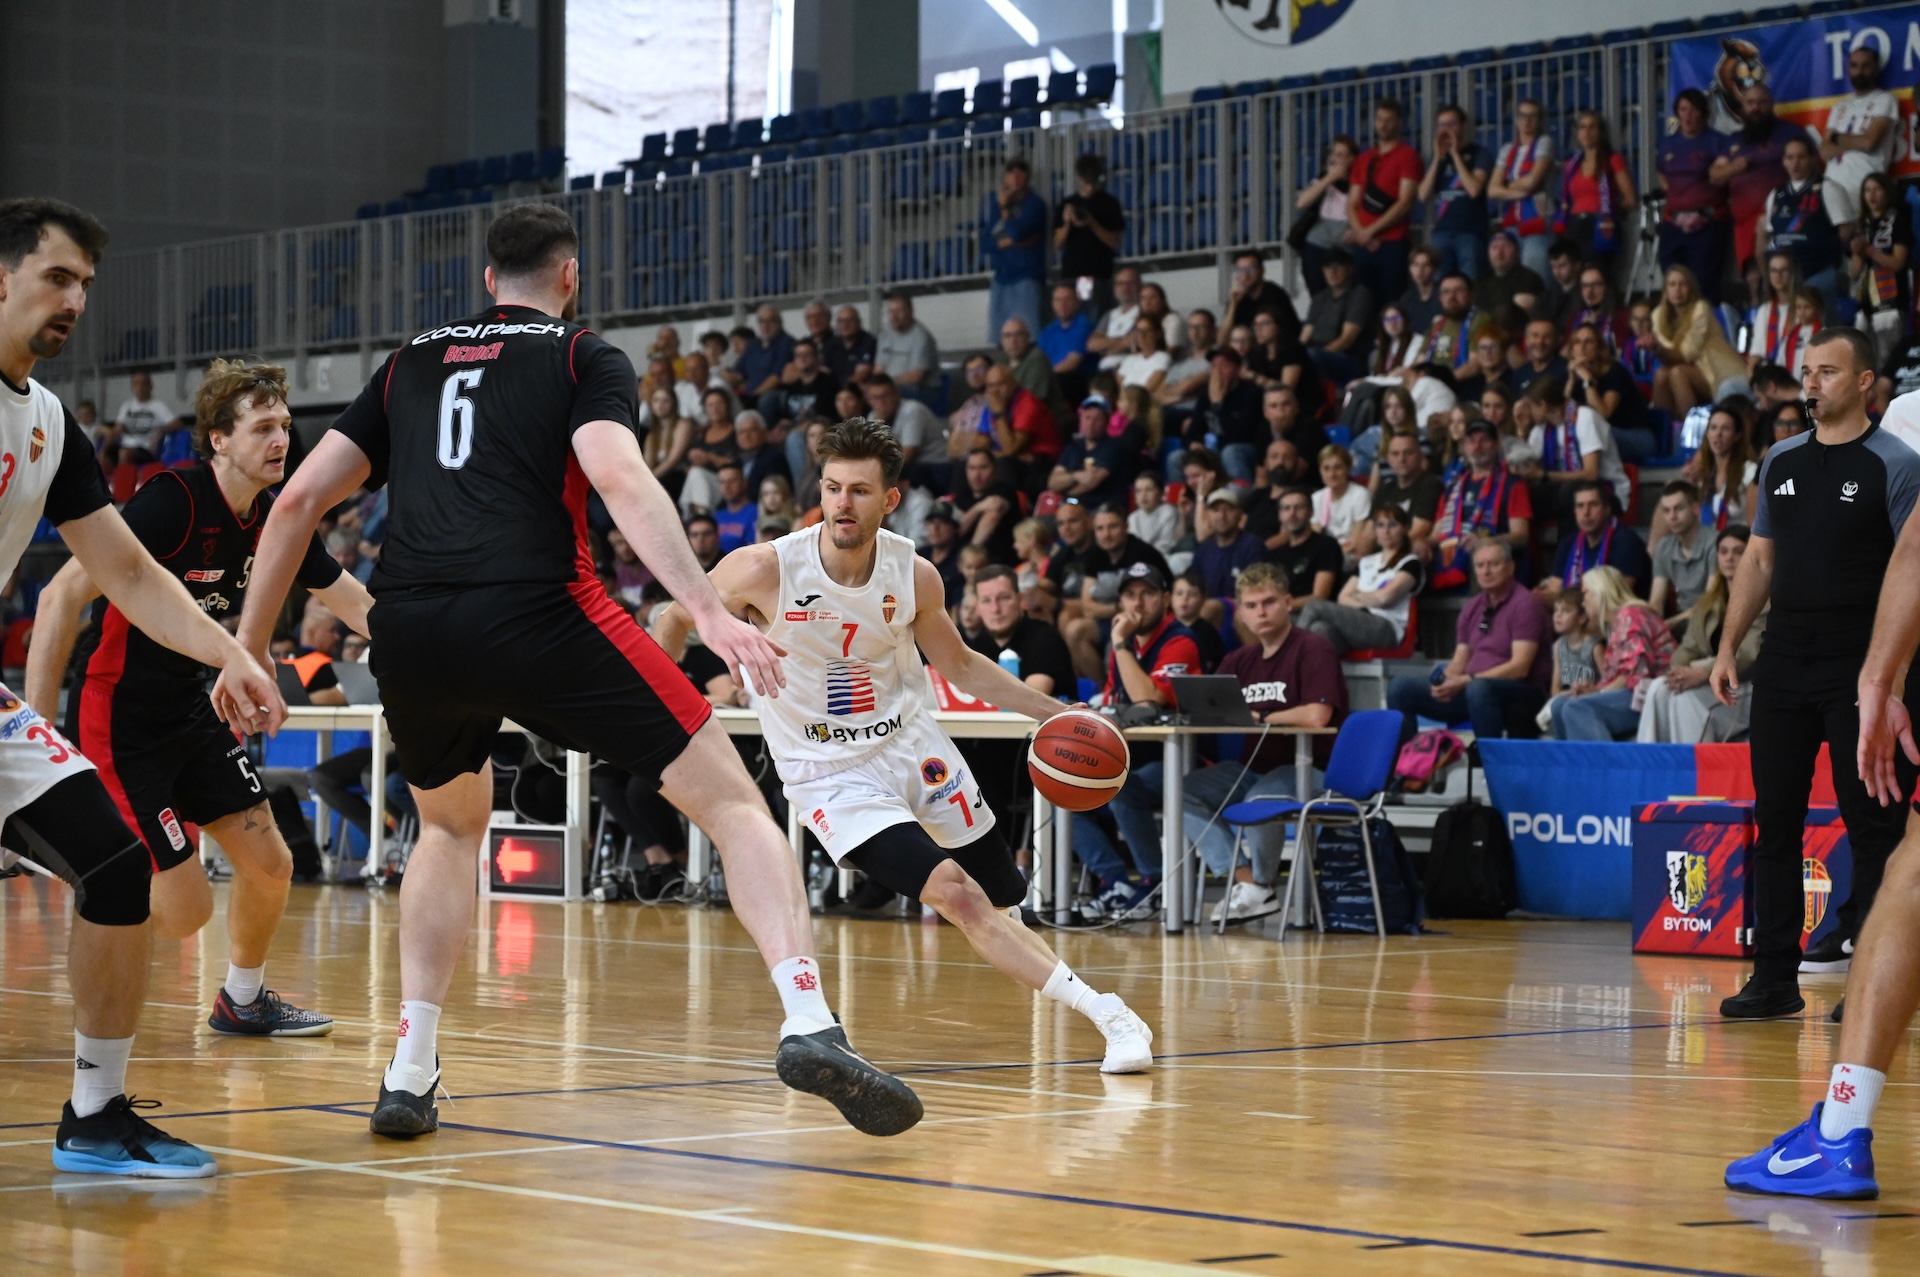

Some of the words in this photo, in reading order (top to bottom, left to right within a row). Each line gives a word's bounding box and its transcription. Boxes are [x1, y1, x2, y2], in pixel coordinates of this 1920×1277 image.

[412, 323, 565, 346] coolpack
[436, 367, 485, 471] 6
[841, 623, 859, 658] 7
[832, 714, 902, 742] BYTOM
[1073, 725, 1096, 739] FIBA
[1055, 746, 1099, 767] molten
[236, 755, 261, 793] 5
[948, 790, 974, 828] 7
[1507, 812, 1633, 847] POLONI
[1663, 916, 1712, 932] BYTOM
